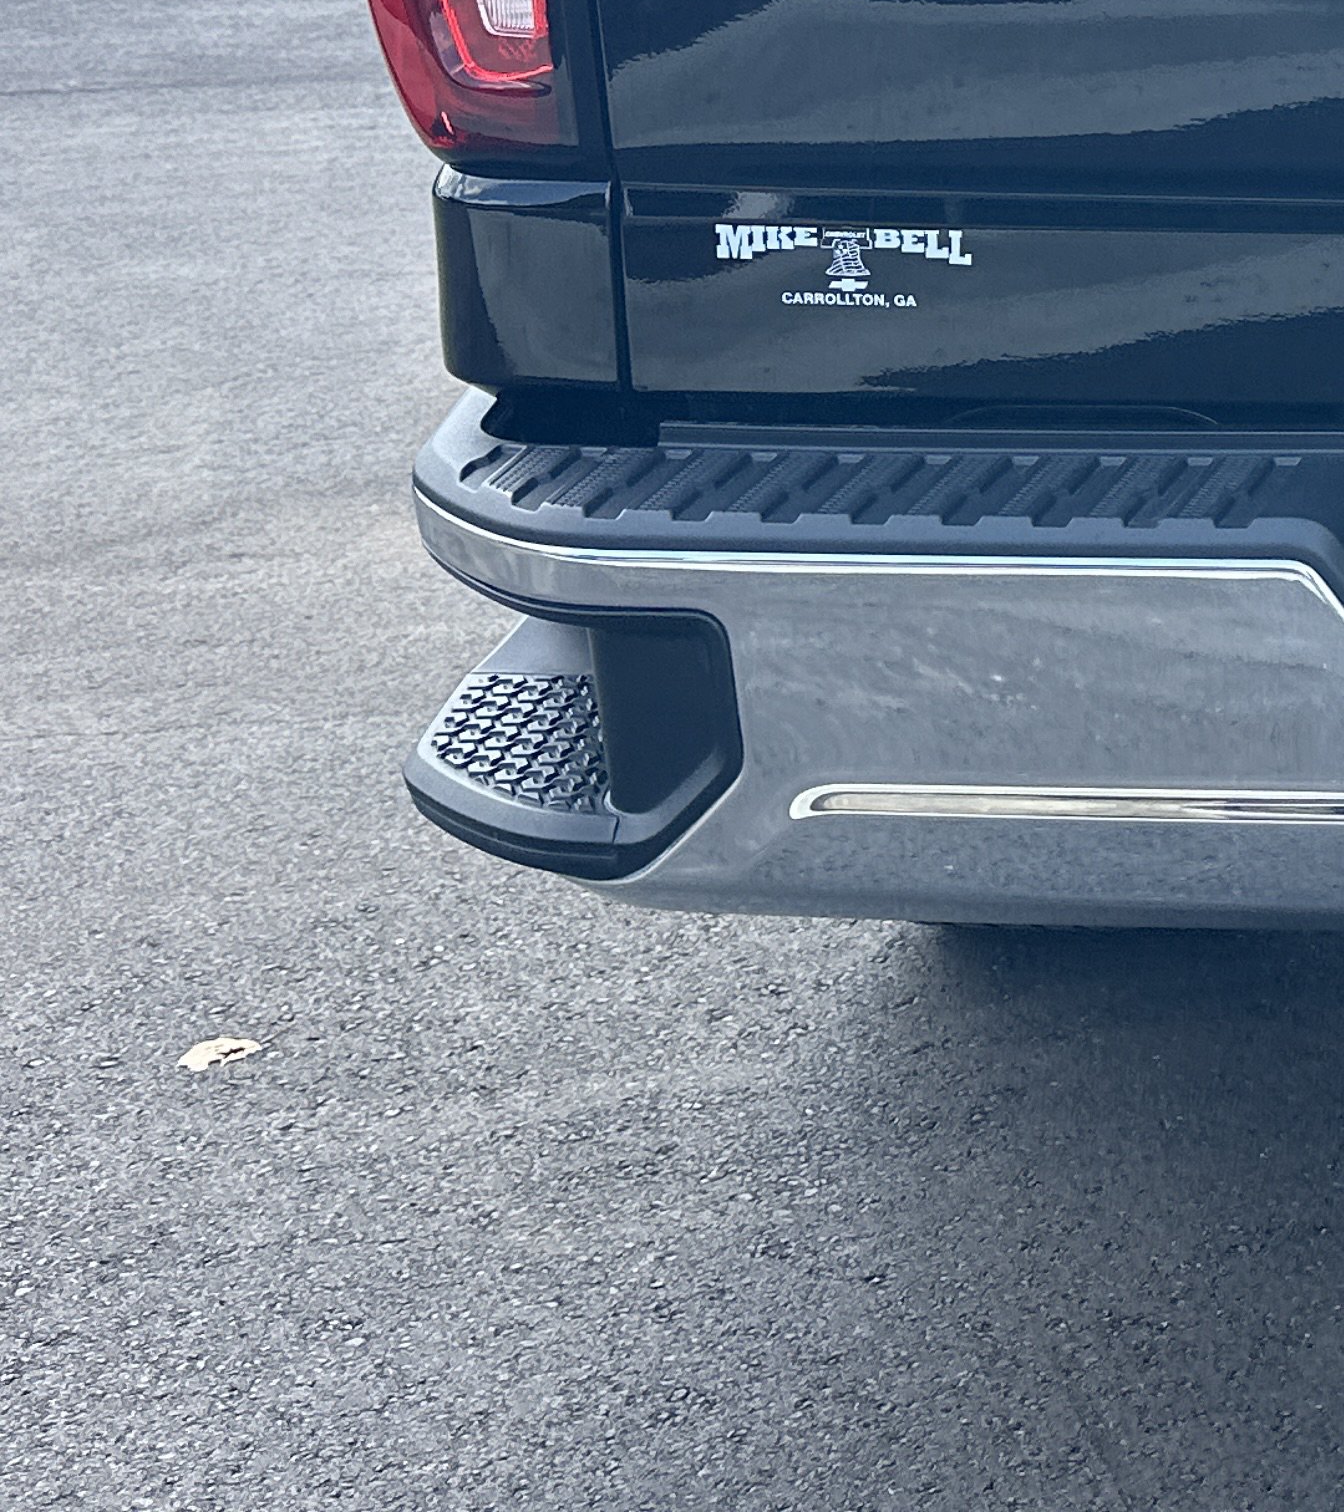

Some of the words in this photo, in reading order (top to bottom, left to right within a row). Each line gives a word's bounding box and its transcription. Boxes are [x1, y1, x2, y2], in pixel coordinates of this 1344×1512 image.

[715, 224, 818, 260] MIKE
[873, 228, 972, 266] BELL
[781, 291, 890, 308] CARROLLTON,
[893, 294, 917, 307] GA
